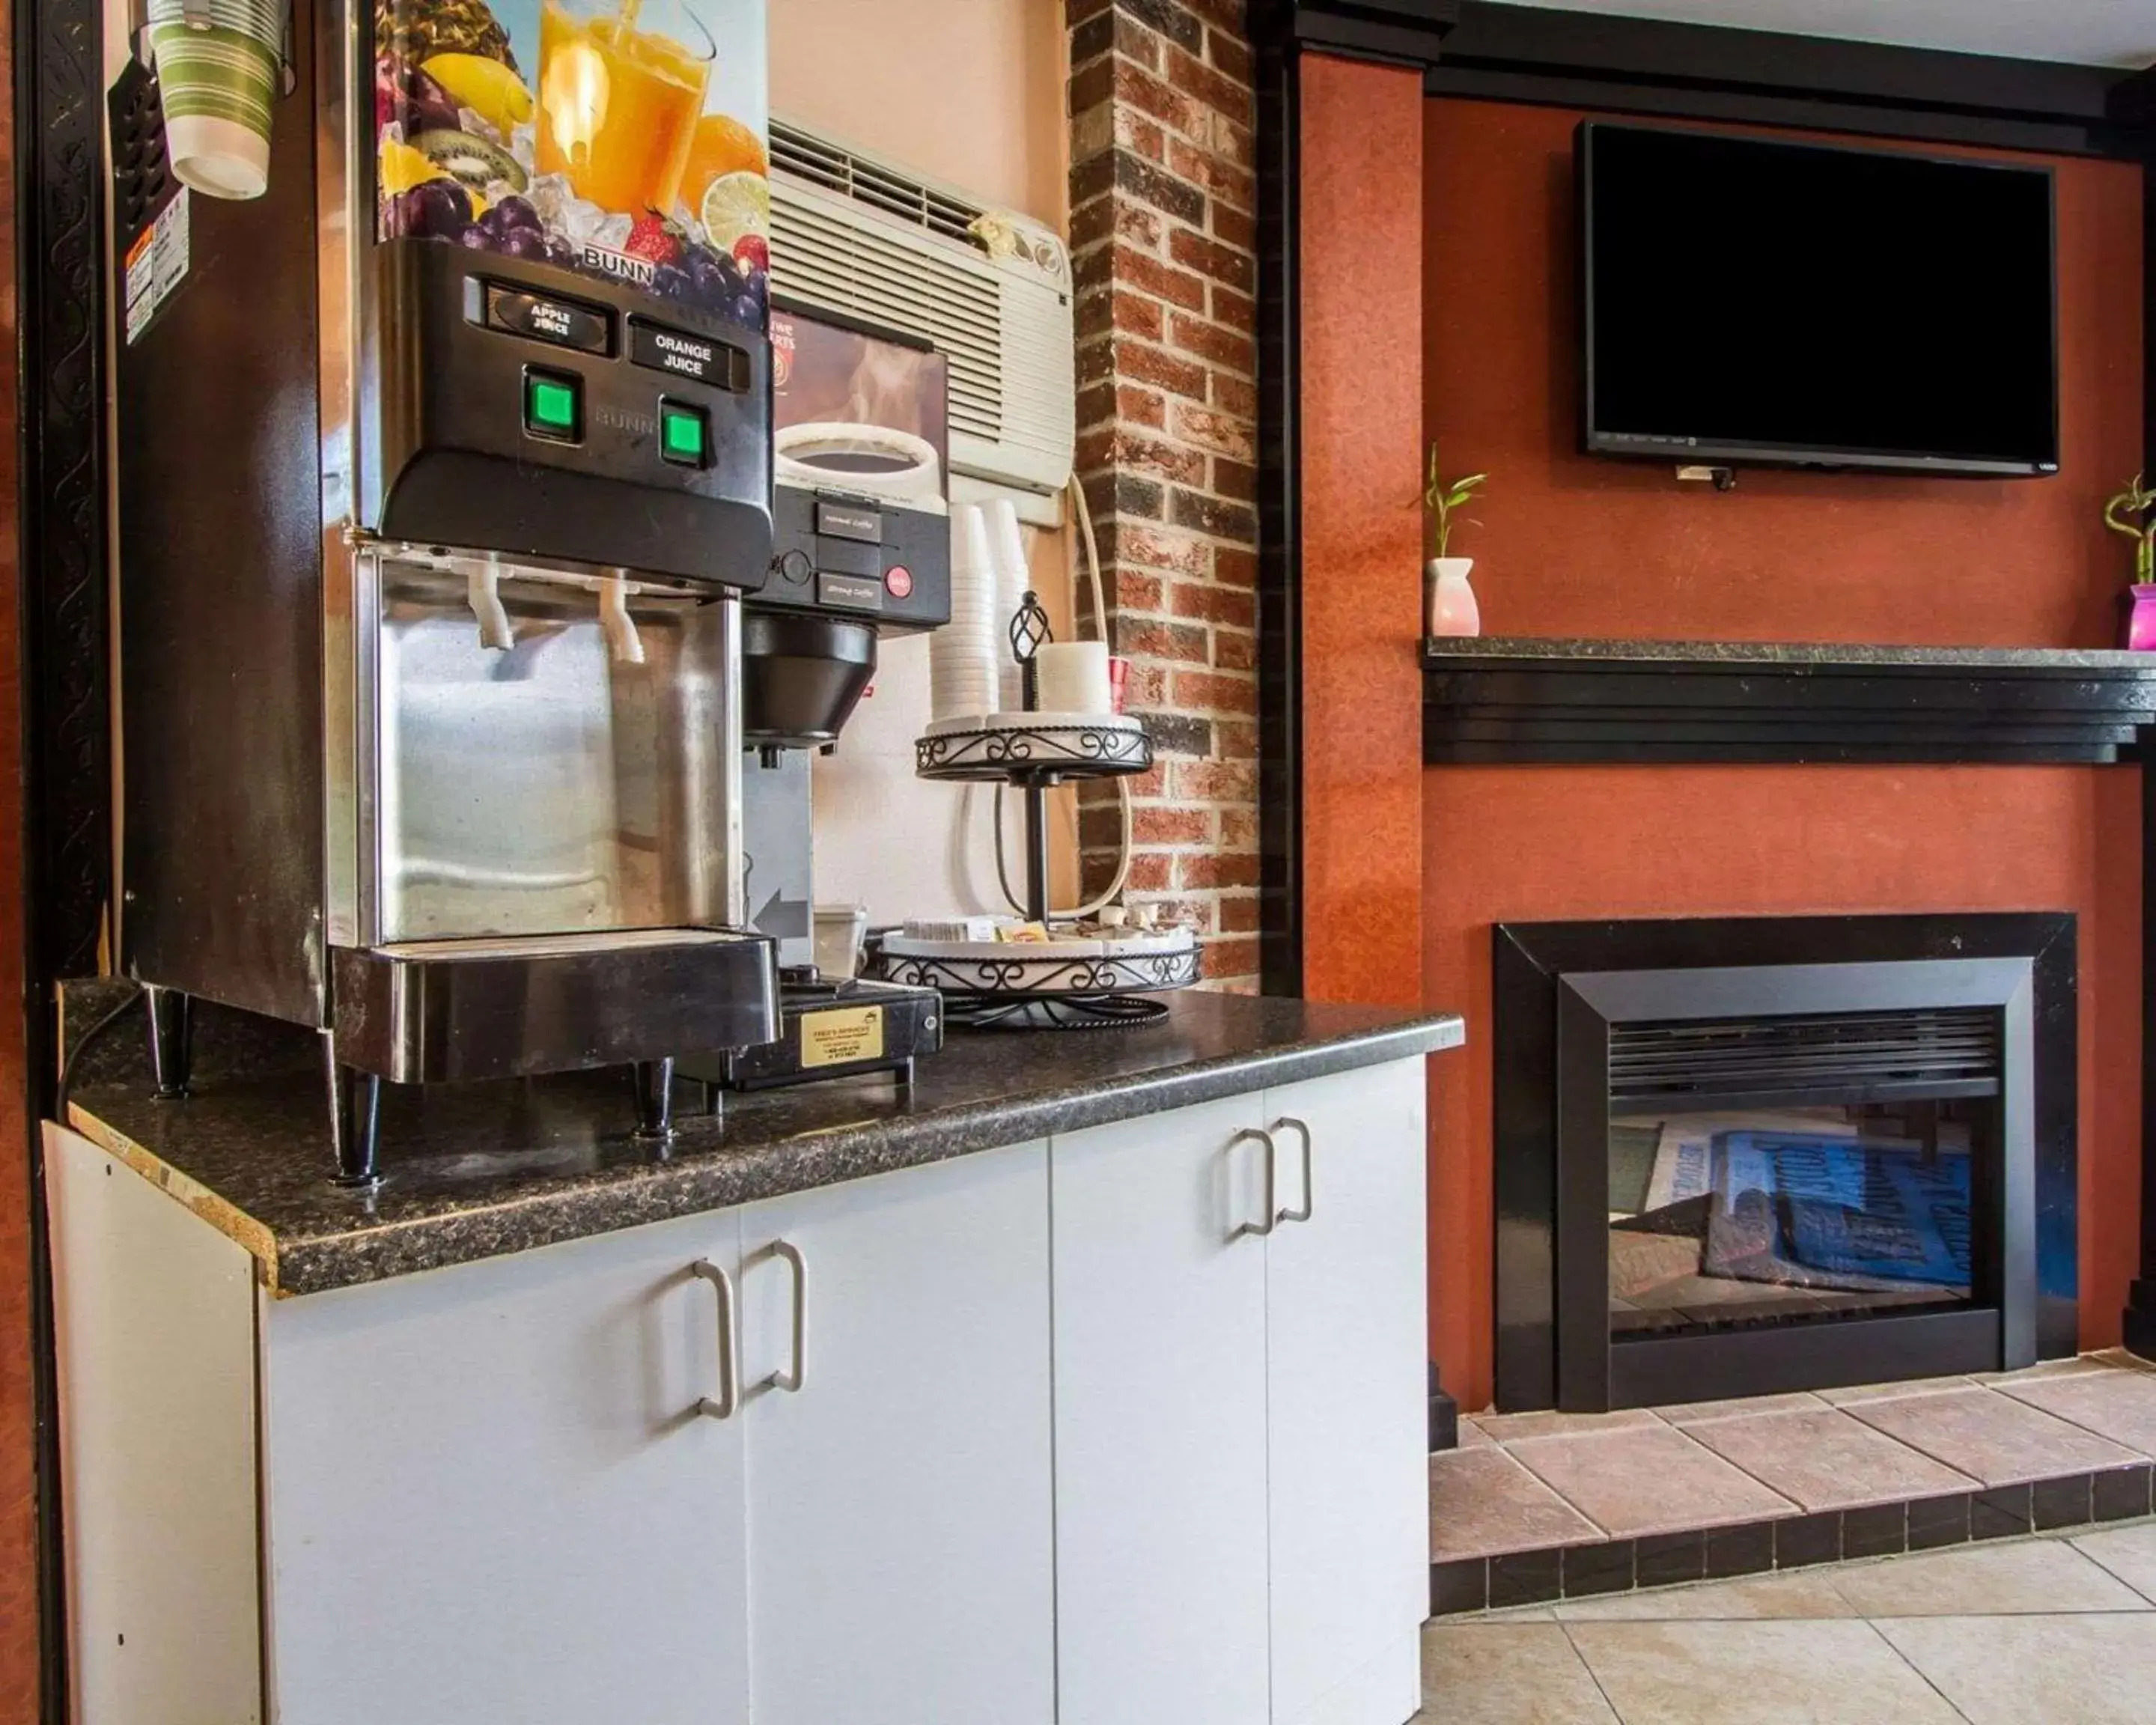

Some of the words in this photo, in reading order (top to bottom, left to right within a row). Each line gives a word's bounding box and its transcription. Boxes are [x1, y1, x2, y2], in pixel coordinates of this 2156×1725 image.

[583, 248, 653, 283] BUNN
[531, 305, 570, 324] APPLE
[656, 335, 711, 362] ORANGE
[664, 353, 702, 375] JUICE
[596, 405, 654, 434] BUNN
